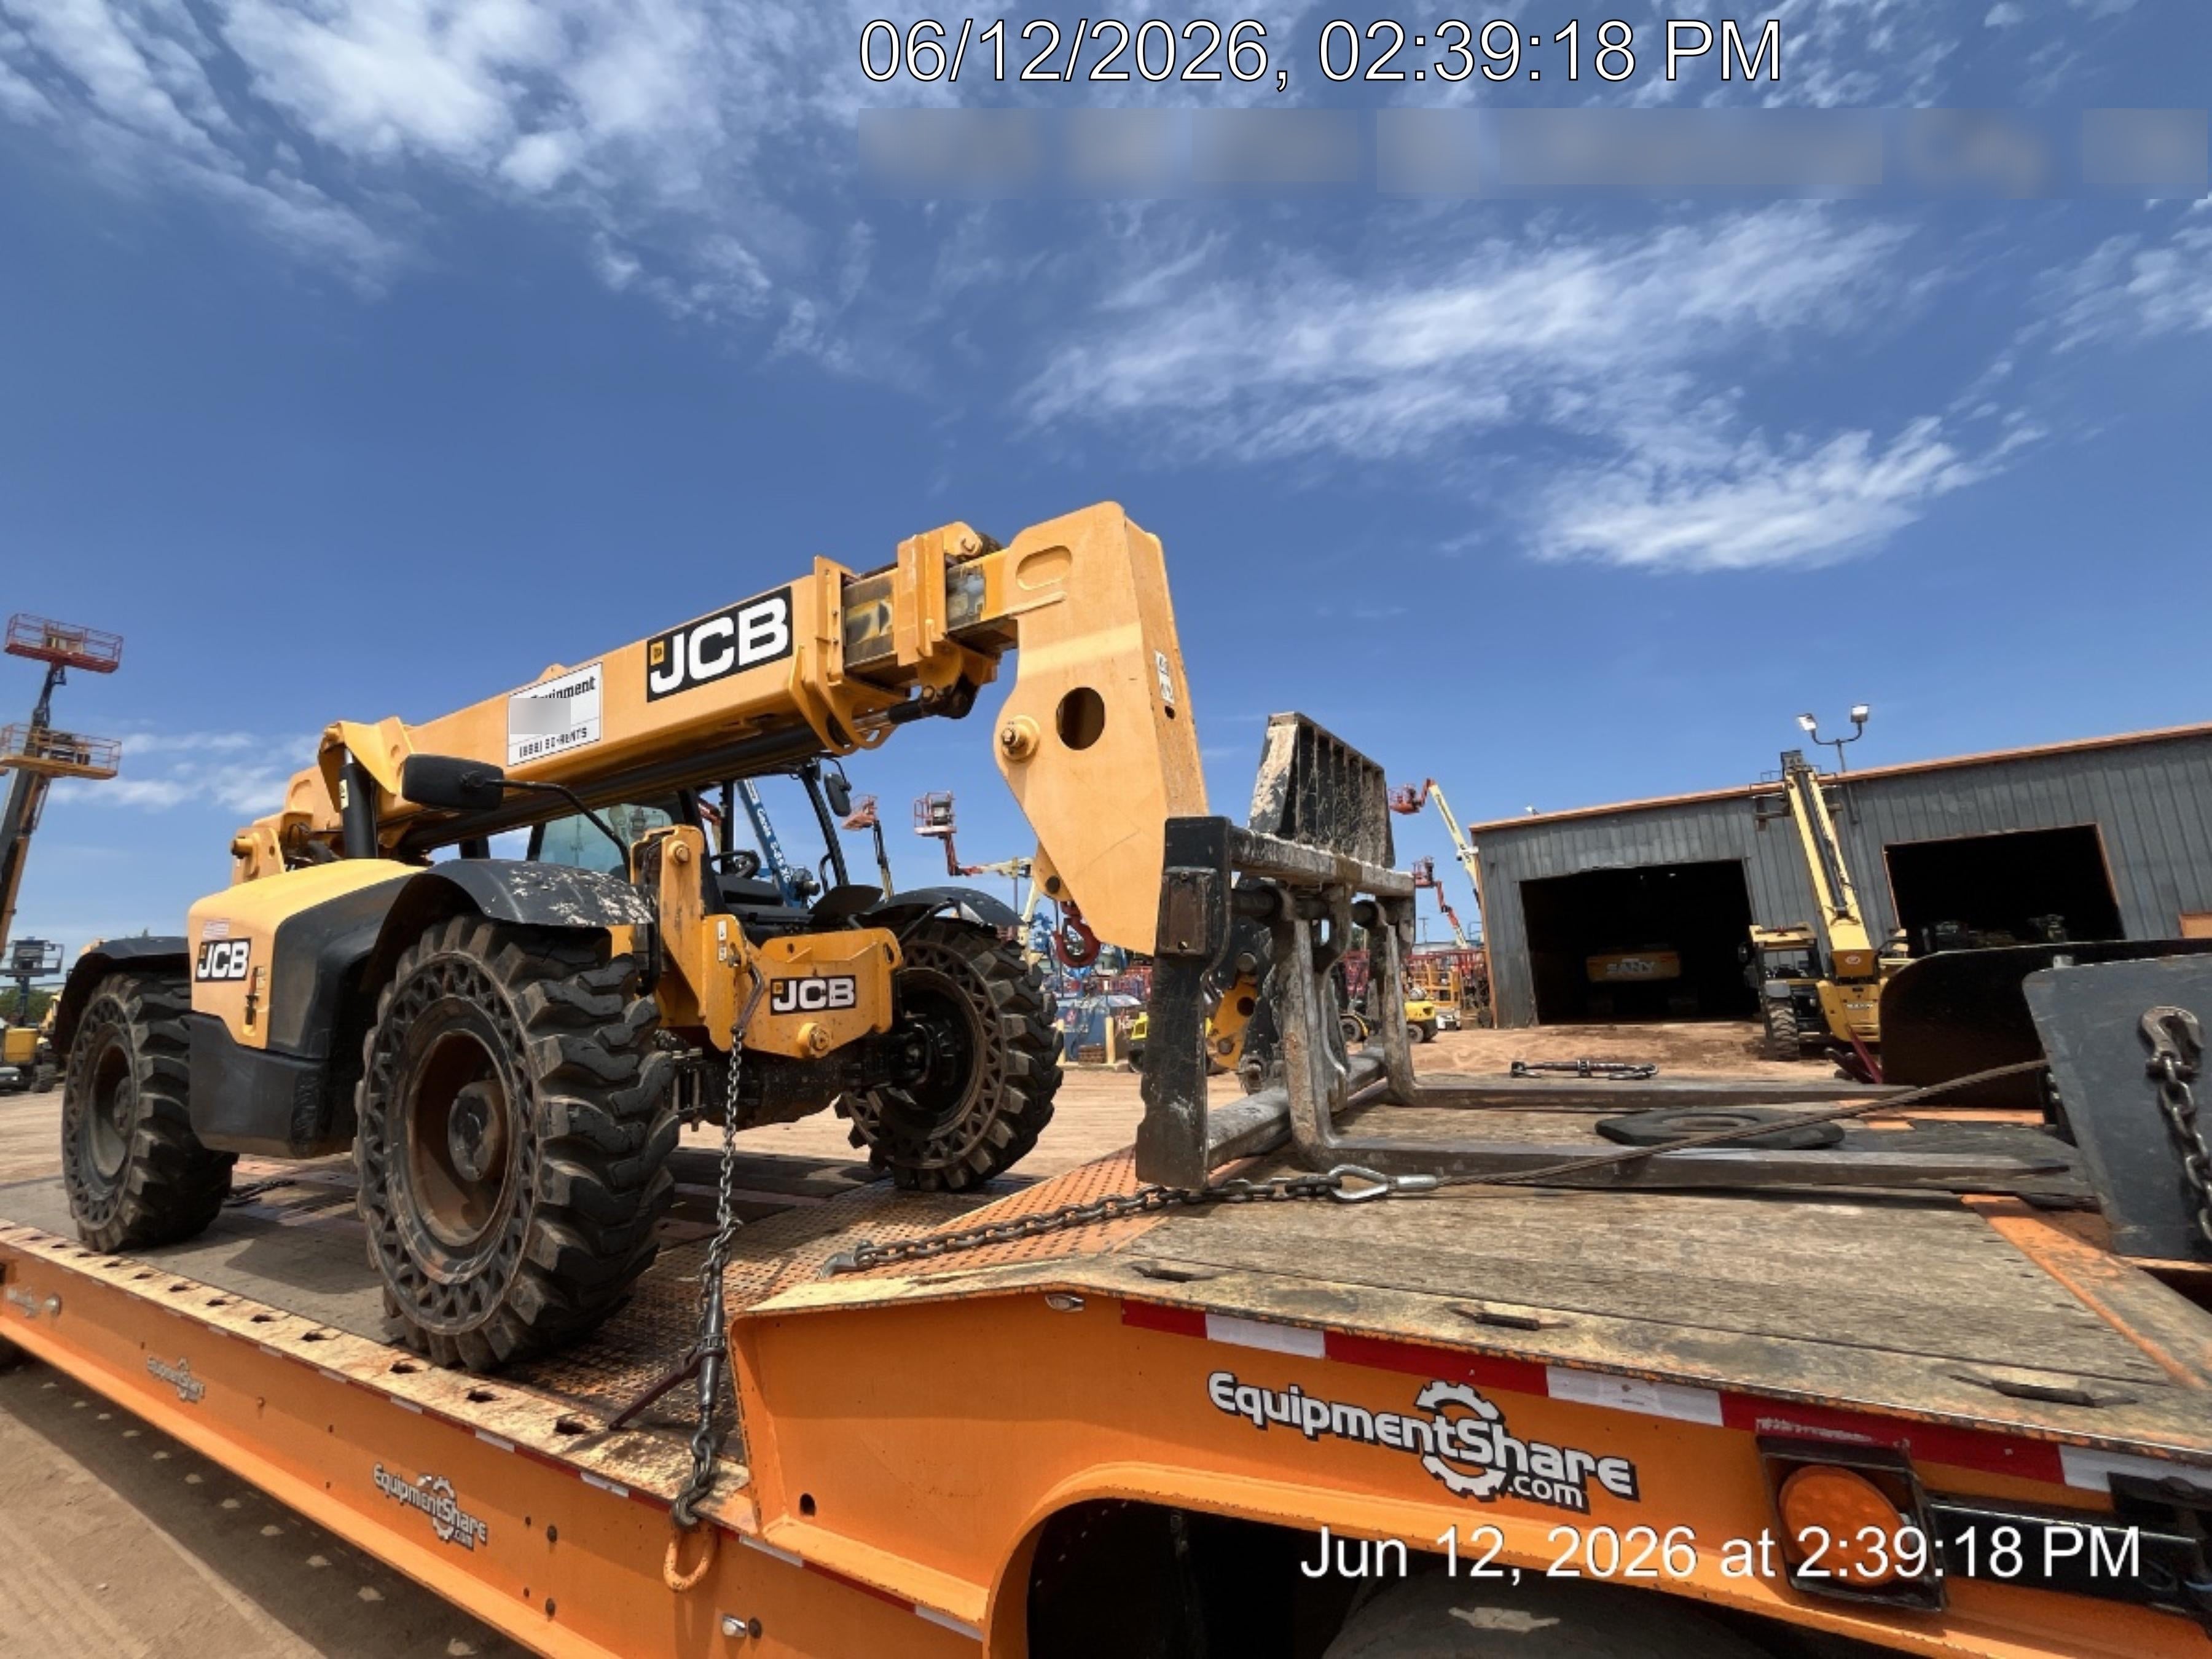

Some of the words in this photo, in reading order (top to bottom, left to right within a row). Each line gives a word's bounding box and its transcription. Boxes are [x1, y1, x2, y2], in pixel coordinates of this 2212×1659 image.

[649, 597, 789, 694] JCB
[197, 941, 249, 978] JCB
[772, 978, 855, 1011] JCB
[1208, 1371, 1637, 1499] EquipmentShare
[374, 1463, 487, 1545] EquipmentShare
[1507, 1475, 1585, 1510] .com
